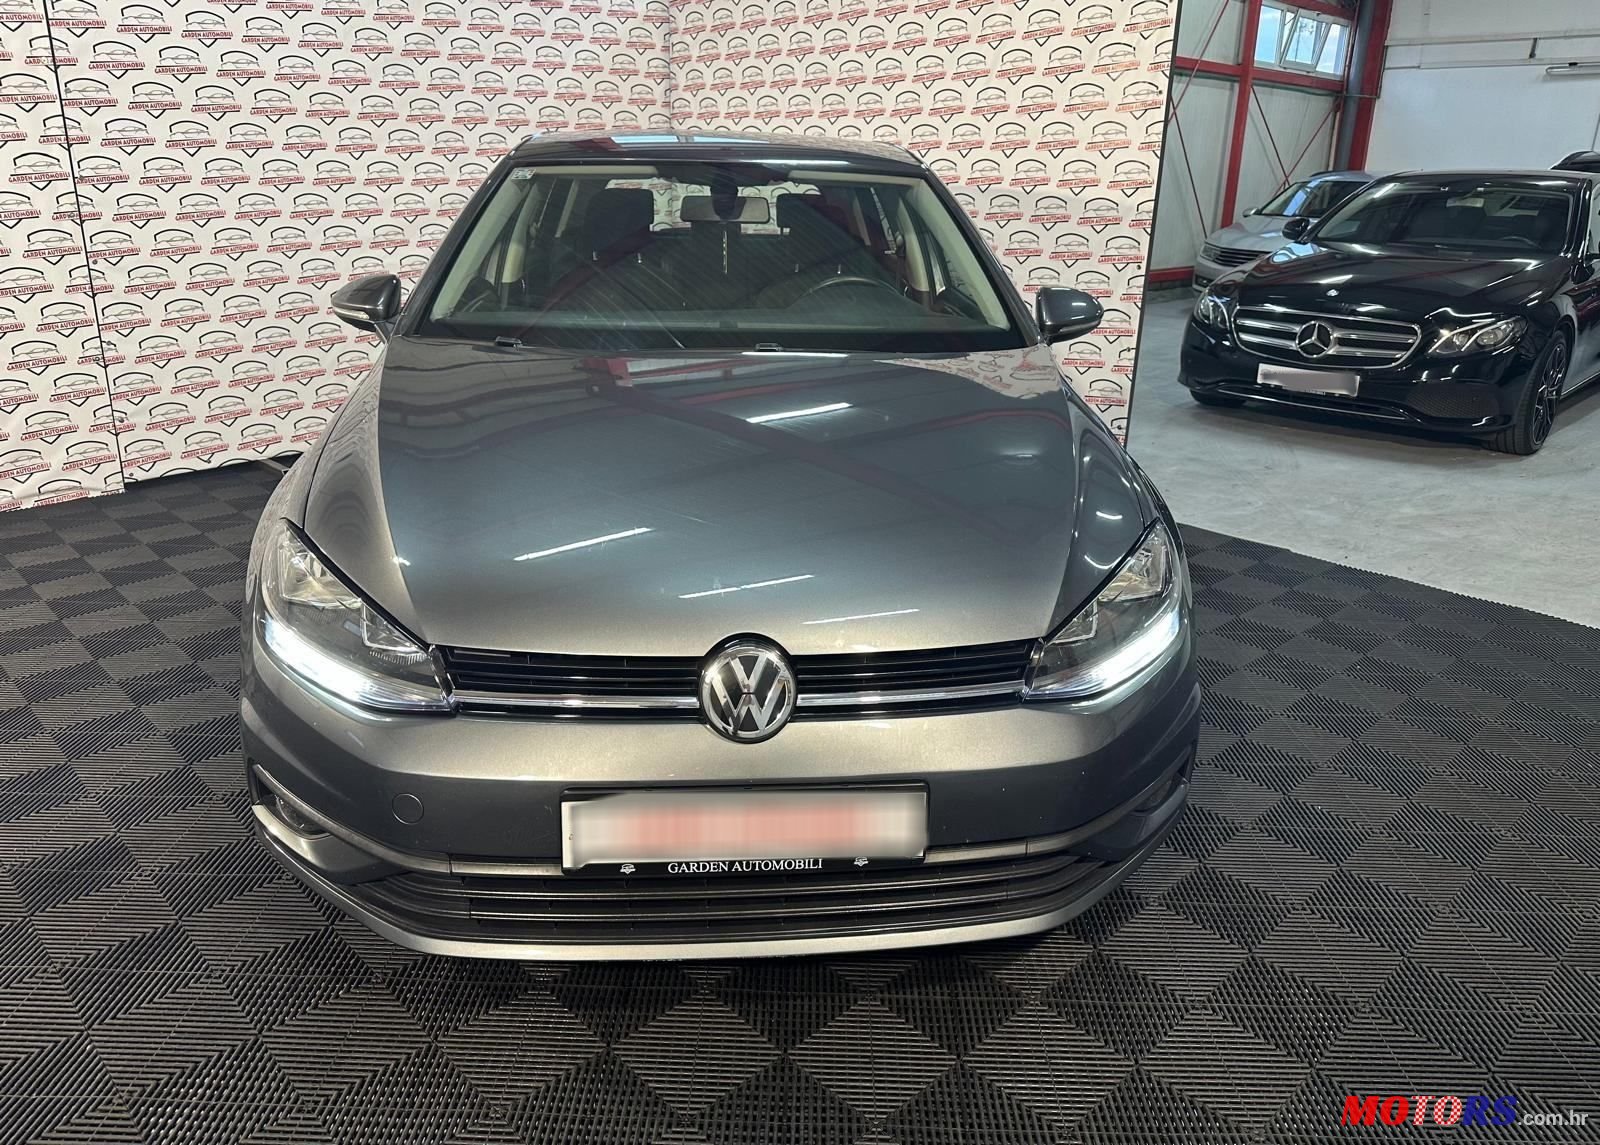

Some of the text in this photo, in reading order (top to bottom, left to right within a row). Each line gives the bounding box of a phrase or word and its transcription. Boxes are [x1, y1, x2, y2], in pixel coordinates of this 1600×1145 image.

[1122, 18, 1173, 33] GARDEN AUTOMOBILI
[149, 101, 182, 109] AUTOMOBILI
[122, 137, 156, 145] AUTOMOBILI
[186, 138, 217, 147] AUTOMOBILI
[245, 140, 274, 148] AUTOMOBILI
[8, 171, 70, 183] GARDEN AUTOMOBILI
[95, 173, 129, 183] AUTOMOBILI
[160, 174, 192, 183] AUTOMOBILI
[220, 175, 250, 184] AUTOMOBILI
[3, 209, 41, 218] AUTOMOBILI
[111, 209, 166, 223] GARDEN AUTOMOBILI
[174, 209, 226, 221] GARDEN AUTOMOBILI
[254, 209, 282, 218] AUTOMOBILI
[22, 250, 46, 259] GARDEN
[47, 245, 82, 256] AUTOMOBILI
[108, 246, 140, 256] AUTOMOBILI
[149, 245, 201, 257] GARDEN AUTOMOBILI
[210, 242, 259, 256] GARDEN AUTOMOBILI
[185, 277, 235, 290] GARDEN AUTOMOBILI
[262, 275, 289, 284] AUTOMOBILI
[17, 282, 54, 294] AUTOMOBILI
[123, 280, 176, 294] GARDEN AUTOMOBILI
[160, 313, 211, 328] GARDEN AUTOMOBILI
[219, 309, 267, 323] GARDEN AUTOMOBILI
[36, 317, 95, 332] GARDEN AUTOMOBILI
[119, 318, 151, 328] AUTOMOBILI
[134, 349, 186, 364] GARDEN AUTOMOBILI
[194, 344, 243, 358] GARDEN AUTOMOBILI
[6, 355, 67, 371] GARDEN AUTOMOBILI
[130, 385, 162, 397] AUTOMOBILI
[170, 379, 220, 394] GARDEN AUTOMOBILI
[2, 394, 39, 404] AUTOMOBILI
[49, 386, 106, 403] GARDEN AUTOMOBILI
[204, 408, 252, 423] GARDEN AUTOMOBILI
[144, 414, 196, 432] GARDEN AUTOMOBILI
[20, 423, 79, 442] GARDEN AUTOMOBILI
[141, 450, 172, 464] AUTOMOBILI
[180, 443, 229, 460] GARDEN AUTOMOBILI
[15, 462, 52, 475] AUTOMOBILI
[61, 452, 117, 472] GARDEN AUTOMOBILI
[668, 859, 822, 873] GARDEN AUTOMOBILI
